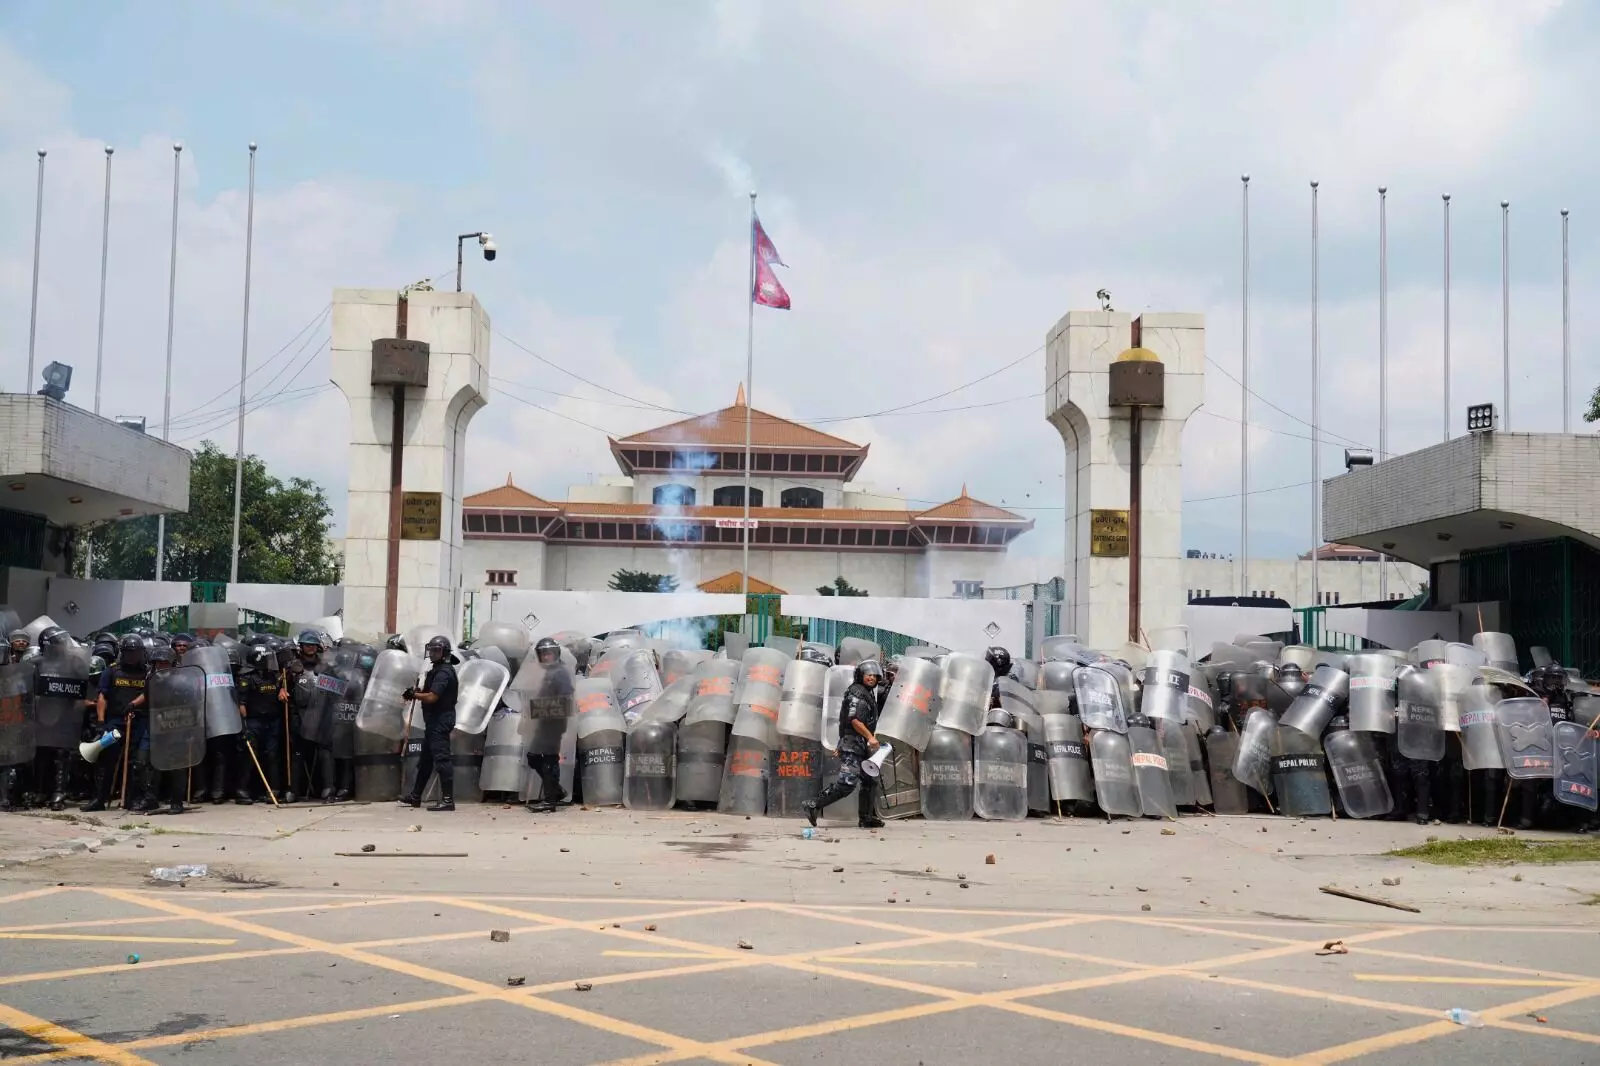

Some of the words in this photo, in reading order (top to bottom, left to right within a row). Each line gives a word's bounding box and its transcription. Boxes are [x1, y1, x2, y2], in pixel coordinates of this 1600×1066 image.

[48, 682, 64, 693] NEPAL
[65, 683, 81, 694] POLICE
[1460, 713, 1479, 724] NEPAL
[589, 748, 614, 756] NEPAL
[1053, 744, 1068, 753] NEPAL
[1068, 745, 1081, 754] POLICE
[589, 756, 616, 764] POLICE
[1279, 760, 1298, 768] NEPAL
[1298, 759, 1318, 768] POLICE
[778, 765, 811, 777] NEPAL
[933, 764, 960, 773] NEPAL
